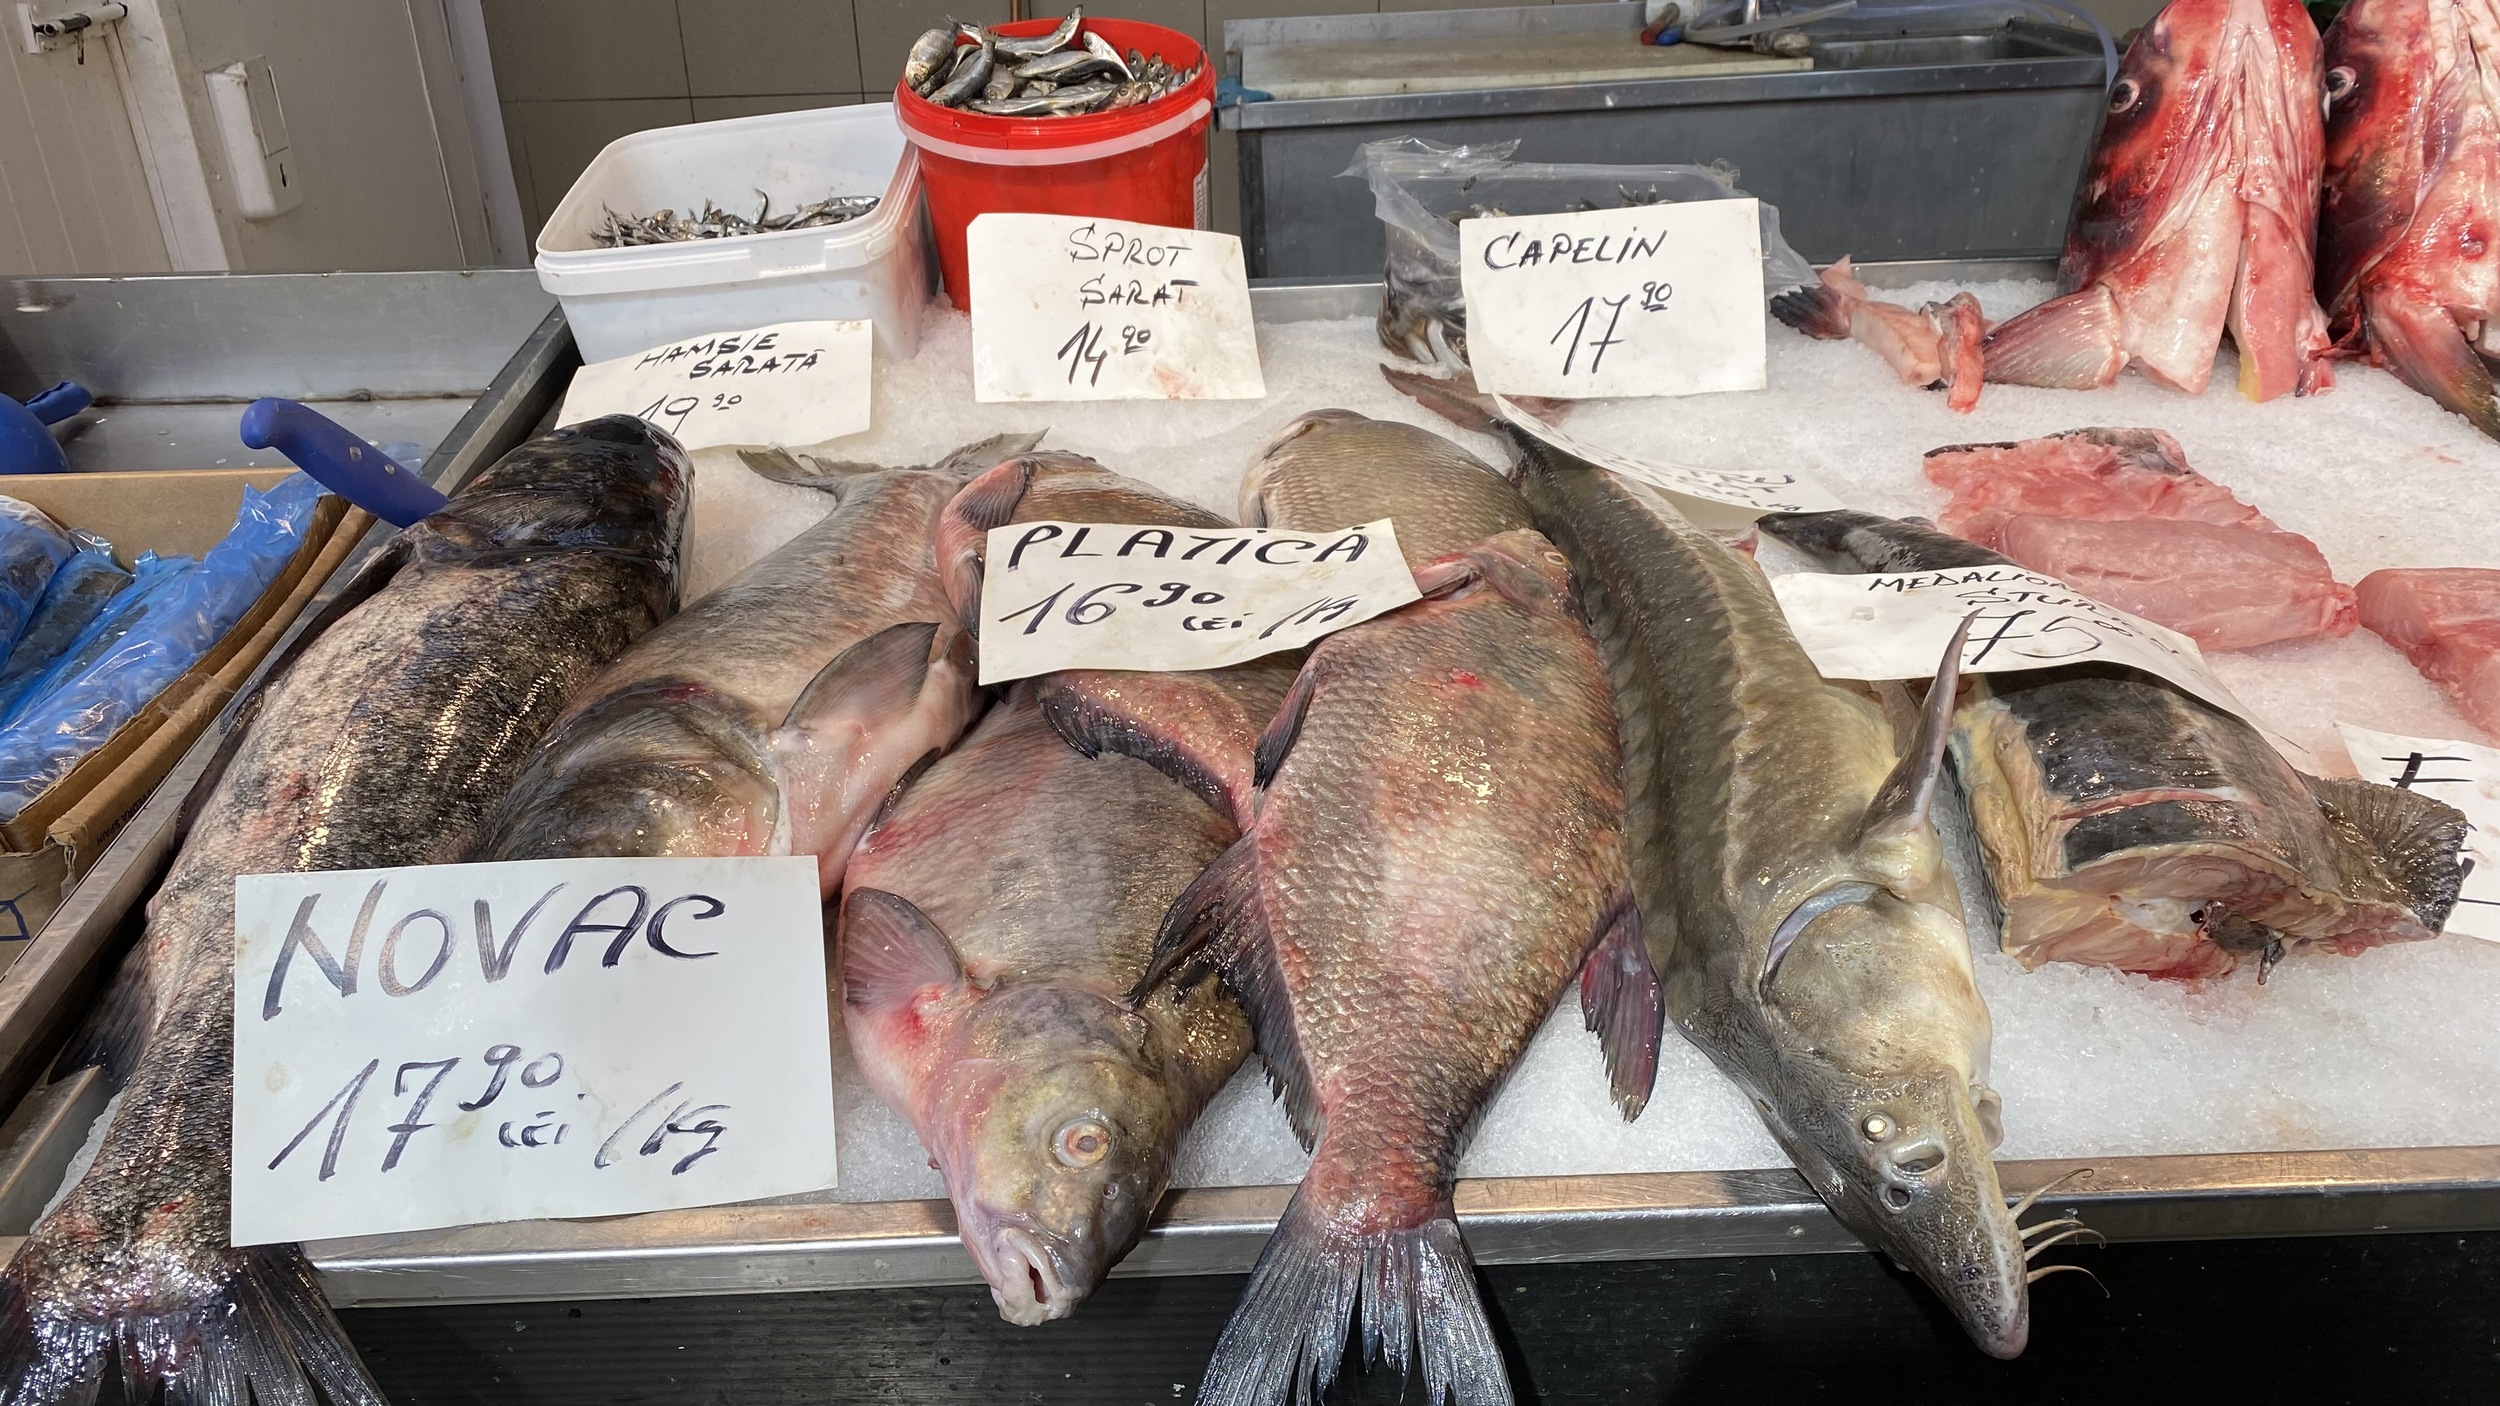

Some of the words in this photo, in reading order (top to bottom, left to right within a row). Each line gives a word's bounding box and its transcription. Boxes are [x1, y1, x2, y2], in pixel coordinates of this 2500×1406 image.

[1069, 222, 1193, 266] SPROT
[1484, 226, 1668, 271] CAPELIN
[1080, 273, 1199, 310] SARAT
[634, 333, 779, 370] HAMSIE
[1057, 321, 1108, 387] 14
[1550, 293, 1631, 376] 17
[1641, 281, 1673, 312] 90
[712, 393, 742, 410] 90
[998, 582, 1143, 635] 16
[1142, 582, 1226, 608] 90
[1961, 609, 2104, 665] 75
[261, 878, 726, 1021] NOVAC
[268, 1057, 462, 1181] 17
[458, 1043, 563, 1111] 90
